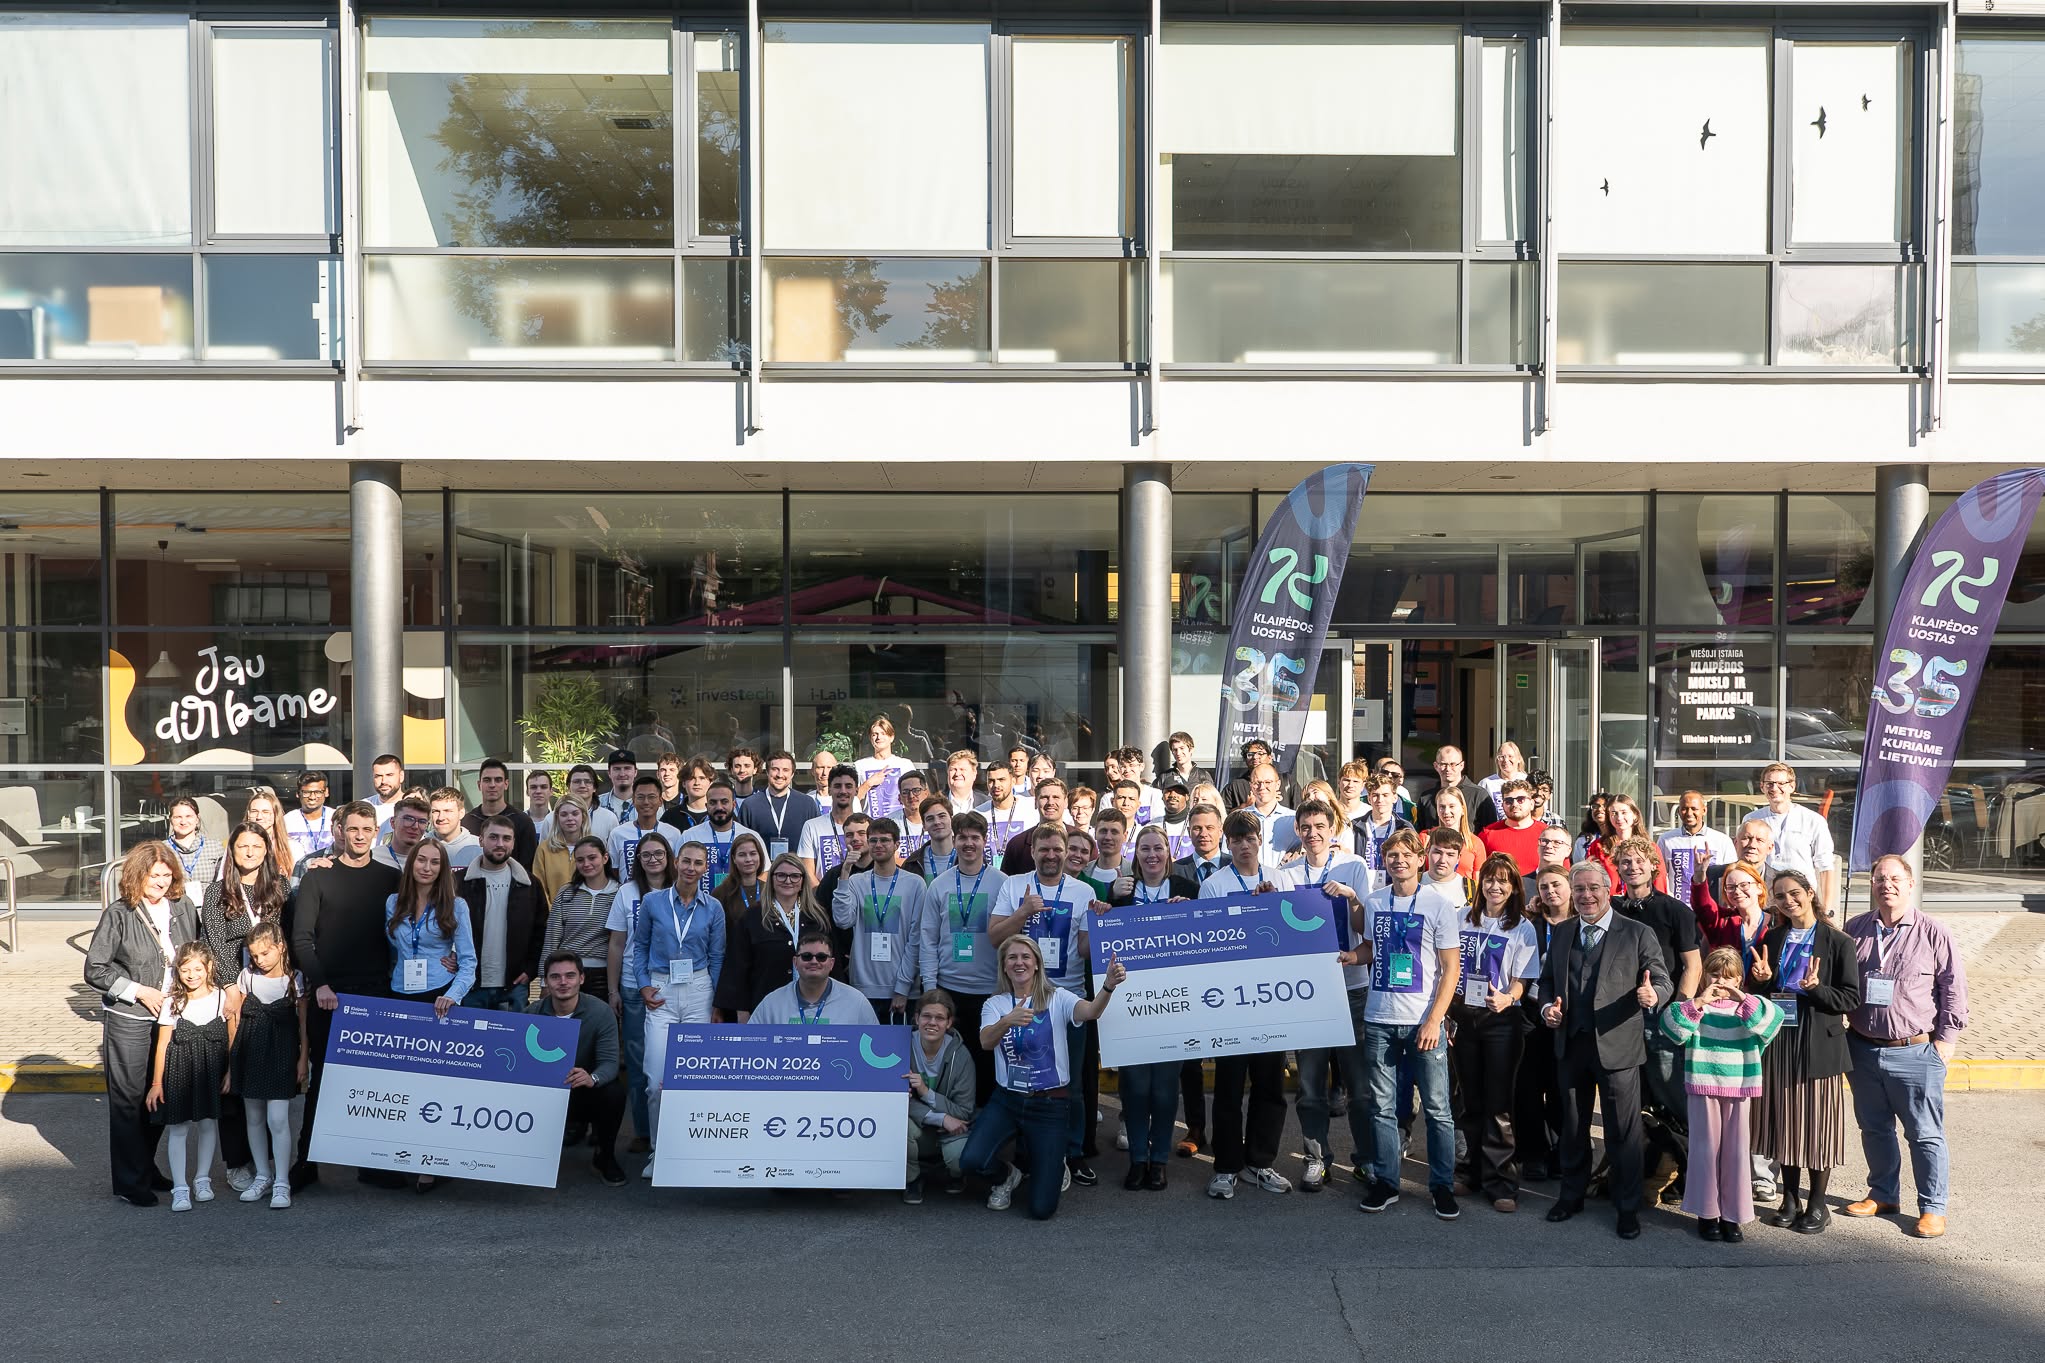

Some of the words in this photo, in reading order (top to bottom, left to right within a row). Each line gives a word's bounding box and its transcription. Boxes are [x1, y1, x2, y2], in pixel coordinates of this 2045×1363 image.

[1254, 613, 1313, 633] KLAIPĖDOS
[1911, 614, 1978, 636] KLAIPĖDOS
[1251, 626, 1295, 641] UOSTAS
[1908, 628, 1956, 645] UOSTAS
[1690, 648, 1716, 658] VIEŠOJI
[1718, 649, 1744, 659] ĮSTAIGA
[195, 646, 265, 696] Jau
[1690, 660, 1744, 674] KLAIPĖDOS
[1688, 676, 1730, 689] MOKSLO
[1734, 676, 1746, 689] IR
[1870, 648, 1968, 718] 35
[696, 687, 775, 701] investech
[810, 688, 847, 701] i-Lab
[1679, 692, 1754, 706] TECHNOLOGIJŲ
[1696, 707, 1735, 720] PARKAS
[1233, 722, 1274, 735] METUS
[1884, 724, 1932, 740] METUS
[1881, 737, 1943, 756] KURIAME
[1878, 750, 1938, 768] LIETUVAI
[1101, 931, 1203, 954] PORTATHON
[1207, 928, 1246, 943] 2026
[1467, 936, 1477, 958] 2026
[1375, 915, 1385, 987] PORTATHON
[1125, 991, 1141, 1002] 2nd
[1146, 986, 1189, 1000] PLACE
[1201, 987, 1224, 1008] €
[1234, 980, 1314, 1007] 1,500
[1128, 1001, 1190, 1017] WINNER
[340, 1030, 441, 1053] PORTATHON
[445, 1041, 484, 1058] 2026
[346, 1049, 389, 1058] INTERNATIONAL
[407, 1056, 446, 1064] TECHNOLOGY
[446, 1060, 482, 1068] HACKATHON
[675, 1057, 777, 1070] PORTATHON
[782, 1057, 821, 1070] 2026
[349, 1089, 364, 1099] 3rd
[367, 1091, 410, 1105] PLACE
[347, 1104, 407, 1122] WINNER
[419, 1102, 443, 1123] €
[451, 1105, 534, 1133] 1,000
[689, 1113, 704, 1122] 1st
[708, 1113, 750, 1122] PLACE
[688, 1128, 748, 1138] WINNER
[763, 1117, 786, 1138] €
[796, 1117, 876, 1141] 2,500
